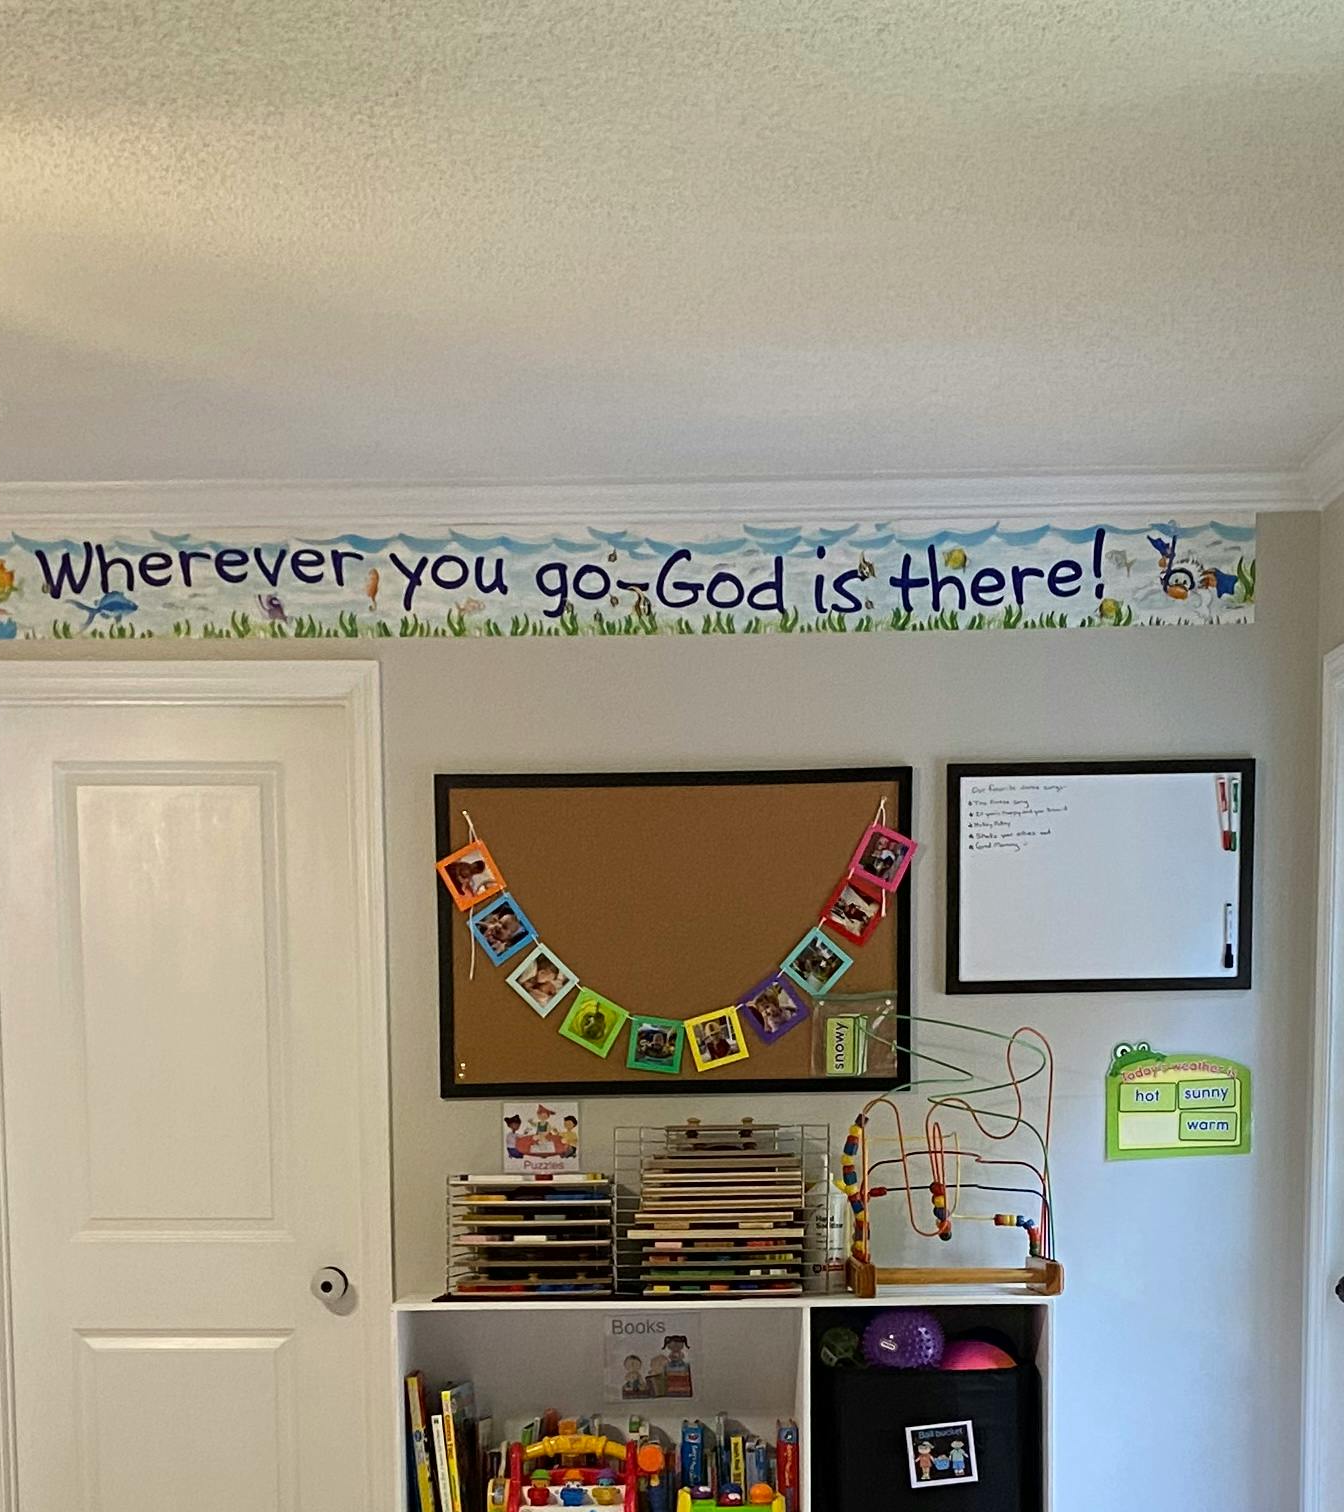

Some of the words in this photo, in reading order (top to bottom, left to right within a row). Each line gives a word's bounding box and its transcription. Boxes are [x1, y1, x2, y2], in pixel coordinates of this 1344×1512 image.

[35, 541, 364, 599] Wherever
[389, 553, 509, 612] you
[815, 545, 863, 614] is
[888, 528, 1106, 612] there!
[835, 1022, 849, 1070] snowy
[1135, 1089, 1160, 1102] hot
[1184, 1087, 1229, 1101] sunny
[1187, 1121, 1229, 1131] warm
[523, 1160, 564, 1171] Puzzles
[612, 1319, 666, 1335] Books
[918, 1431, 934, 1439] Ball
[936, 1428, 963, 1437] bucket
